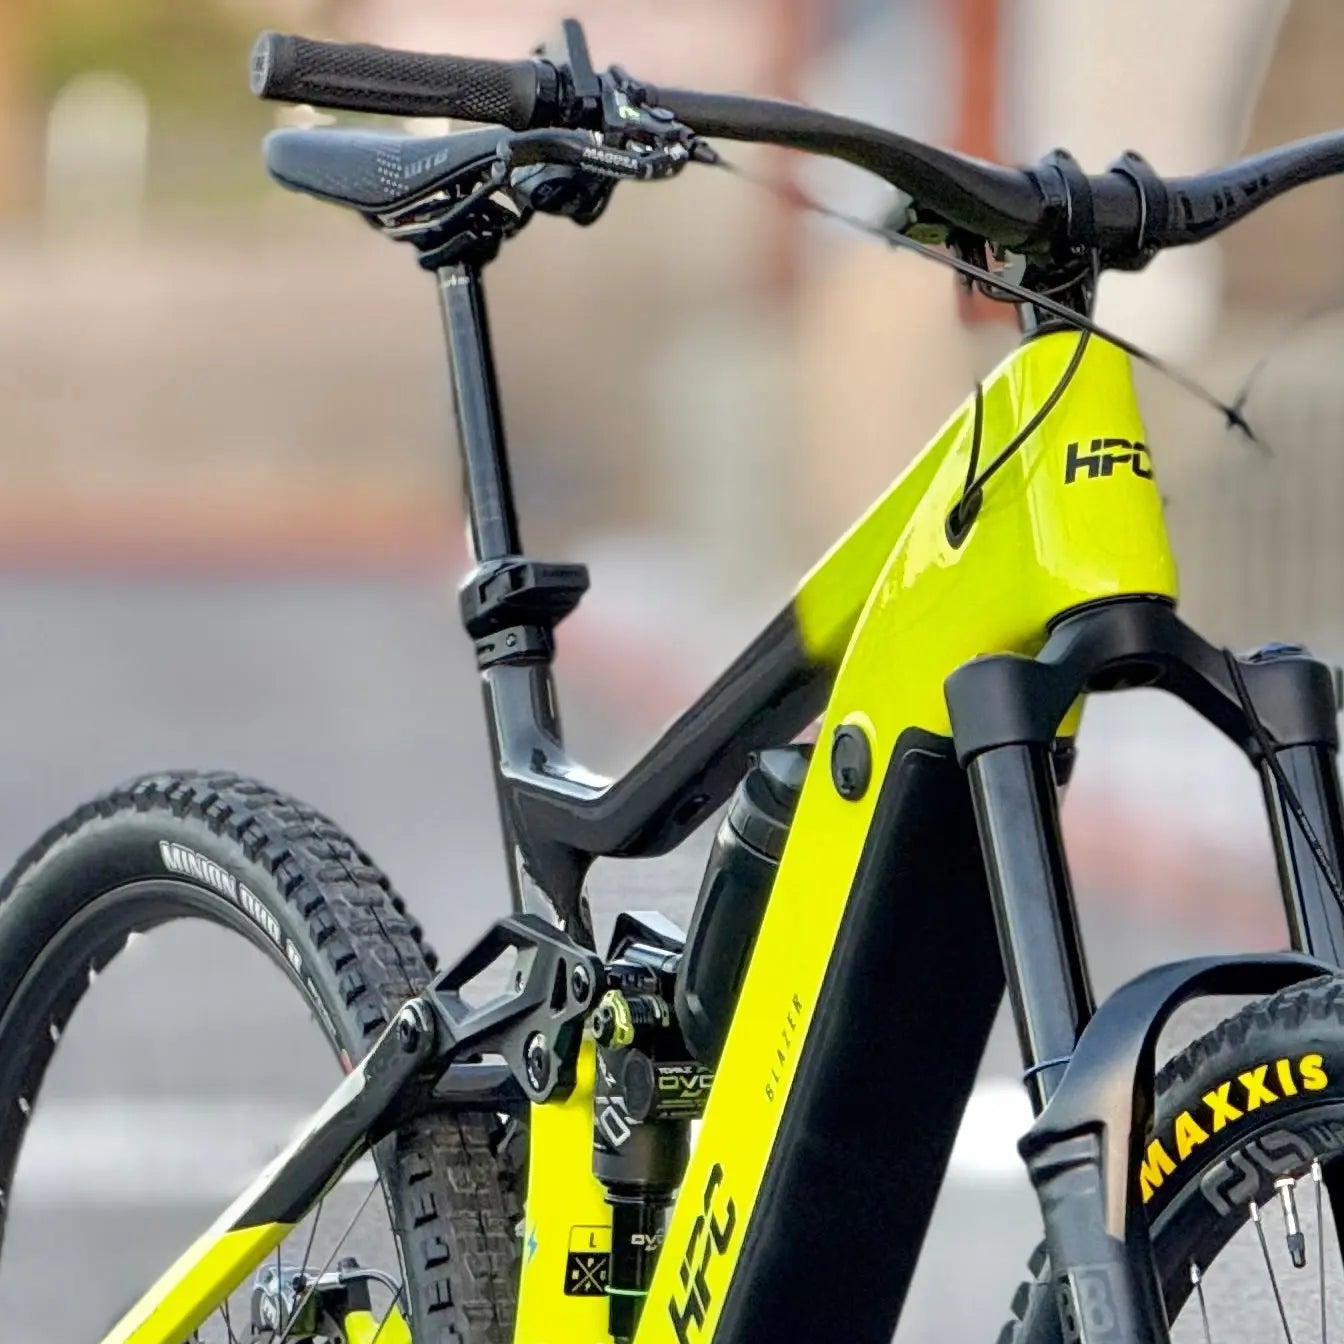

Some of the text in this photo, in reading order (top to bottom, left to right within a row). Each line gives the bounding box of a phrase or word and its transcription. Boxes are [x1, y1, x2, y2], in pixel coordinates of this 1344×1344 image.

[1064, 438, 1153, 485] HPC
[765, 993, 803, 1103] BLAZER
[1139, 1053, 1329, 1205] MAXXIS
